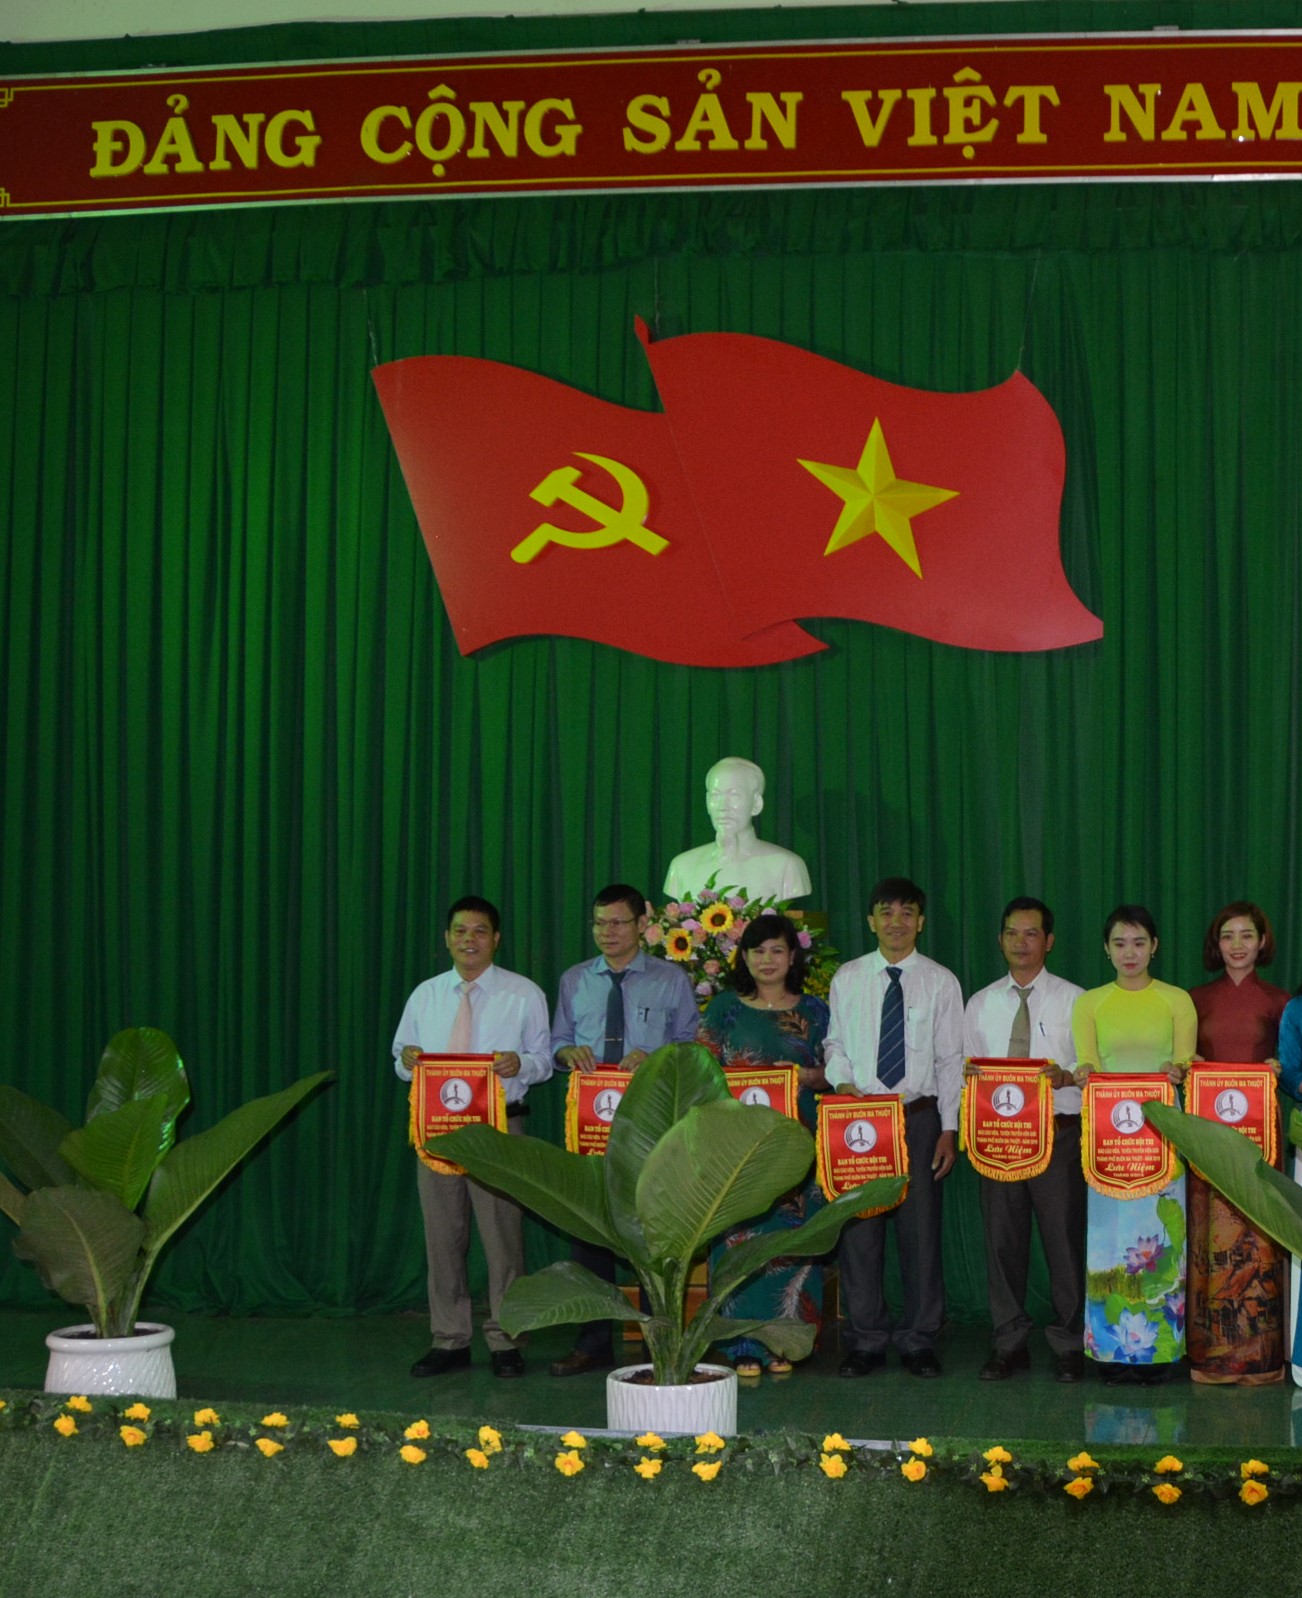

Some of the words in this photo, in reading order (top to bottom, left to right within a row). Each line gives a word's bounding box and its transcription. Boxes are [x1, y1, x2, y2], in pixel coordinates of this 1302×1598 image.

[90, 94, 321, 177] ĐẢNG
[360, 84, 582, 177] CỘNG
[623, 69, 803, 154] SẢN
[842, 67, 1060, 159] VIỆT
